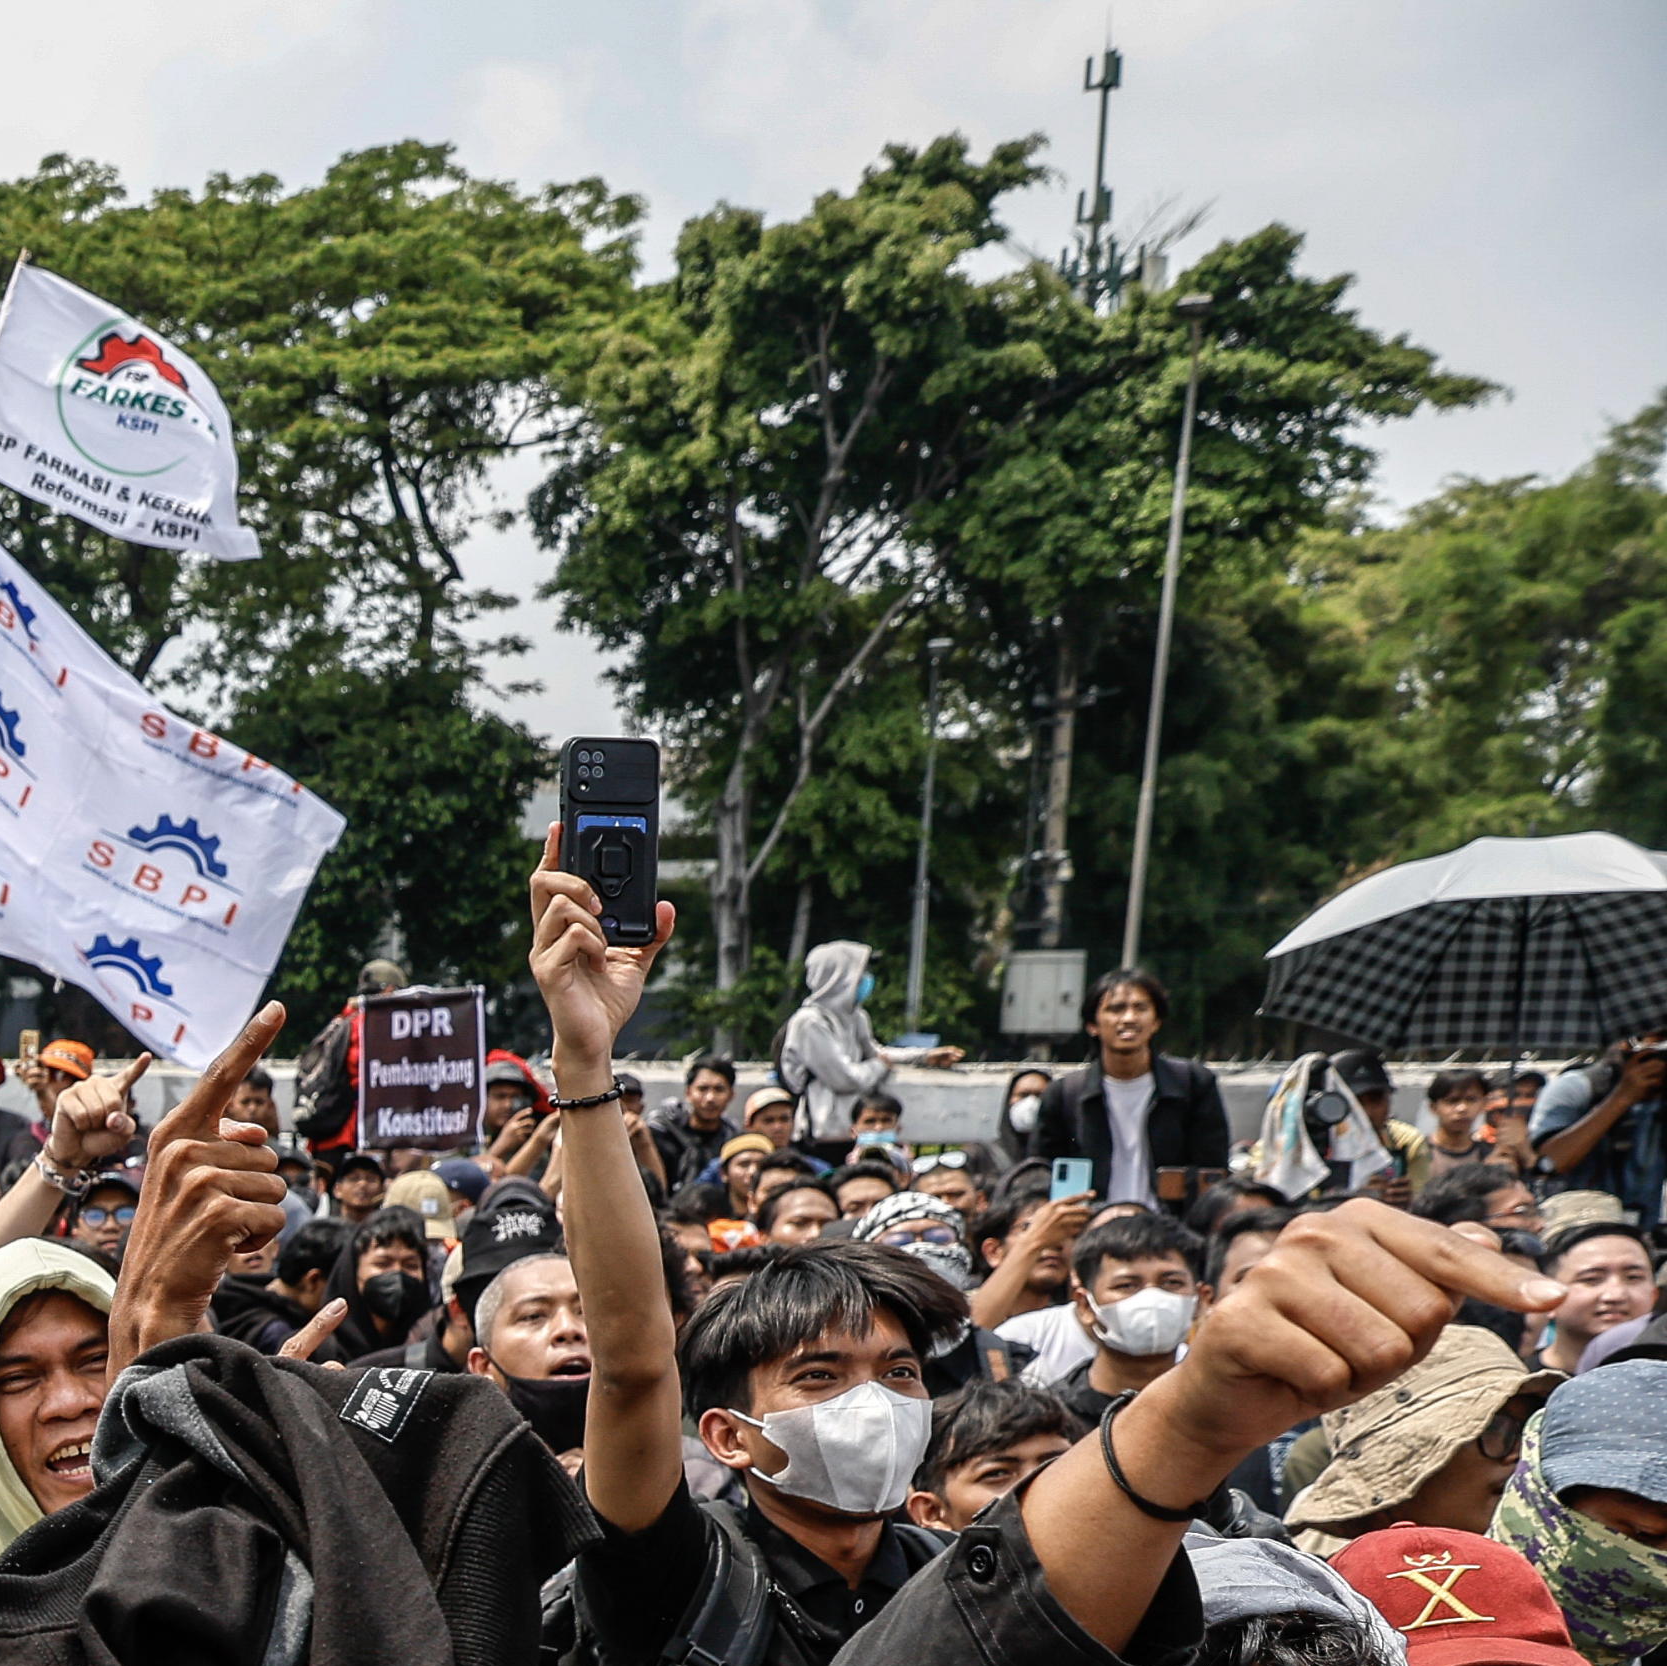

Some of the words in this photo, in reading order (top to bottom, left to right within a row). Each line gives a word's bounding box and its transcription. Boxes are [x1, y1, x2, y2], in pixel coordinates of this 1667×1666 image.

[70, 378, 187, 419] FARKES
[117, 413, 160, 435] KSPI
[24, 444, 112, 497] FARMASI
[30, 472, 128, 526] Reformasi
[152, 518, 200, 543] KSPI
[391, 1006, 454, 1040] DPR
[369, 1054, 475, 1092] Pembangkang
[377, 1104, 470, 1137] Konstitusi
